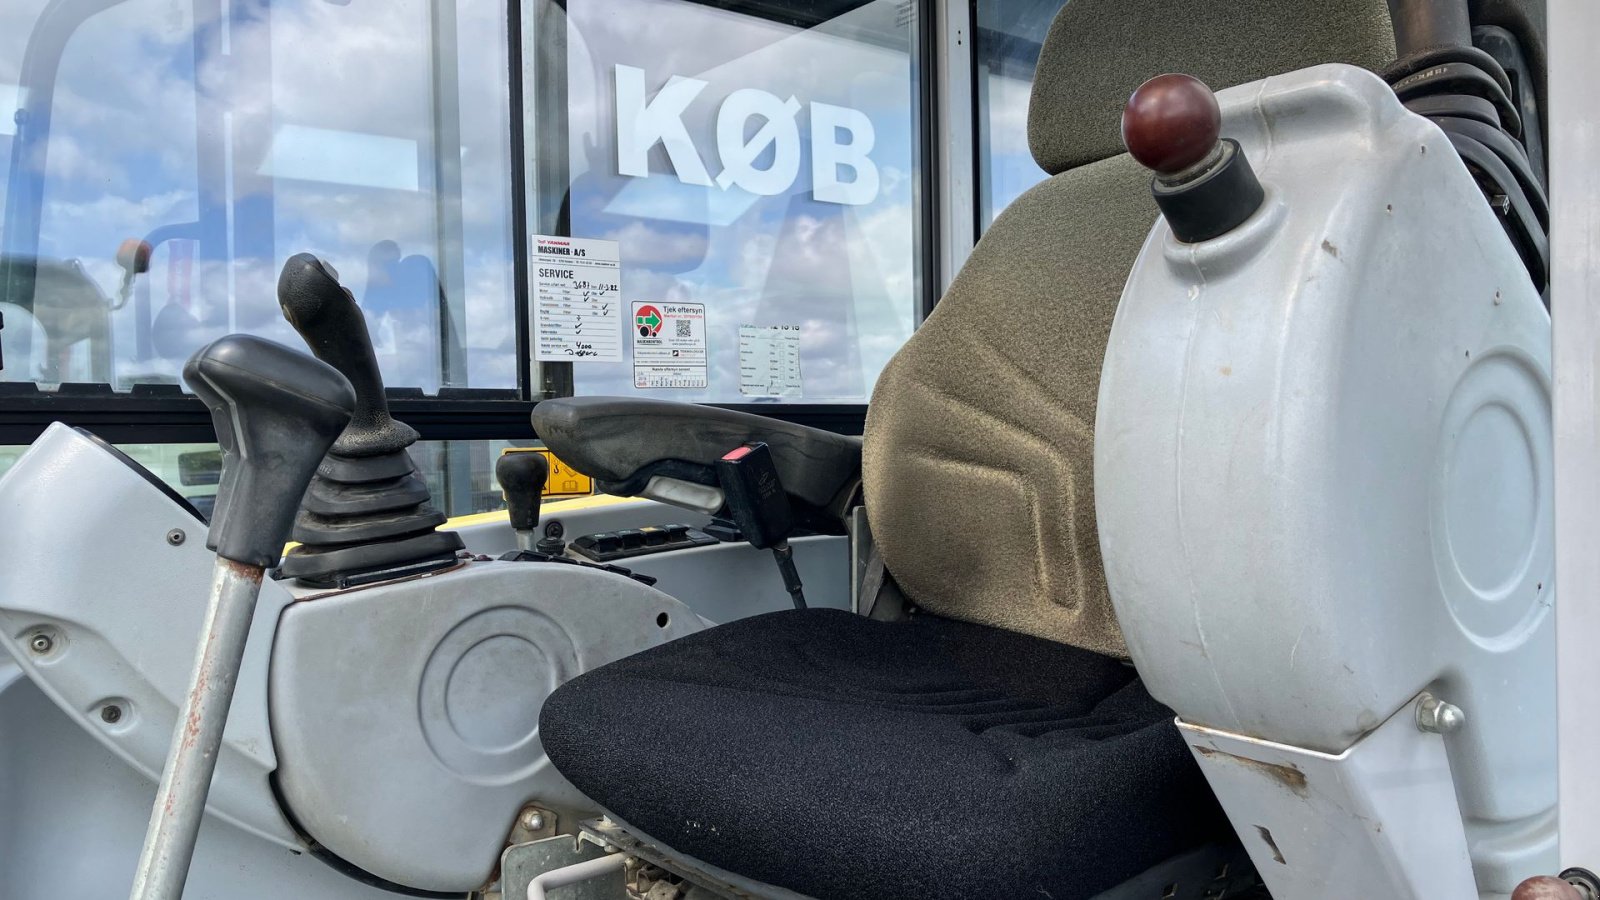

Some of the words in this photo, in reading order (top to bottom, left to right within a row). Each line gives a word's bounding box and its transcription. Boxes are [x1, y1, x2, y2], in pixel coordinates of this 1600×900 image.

[615, 63, 880, 206] KØB
[538, 245, 571, 256] MASKINER
[574, 248, 586, 257] A/S
[539, 268, 574, 279] SERVICE
